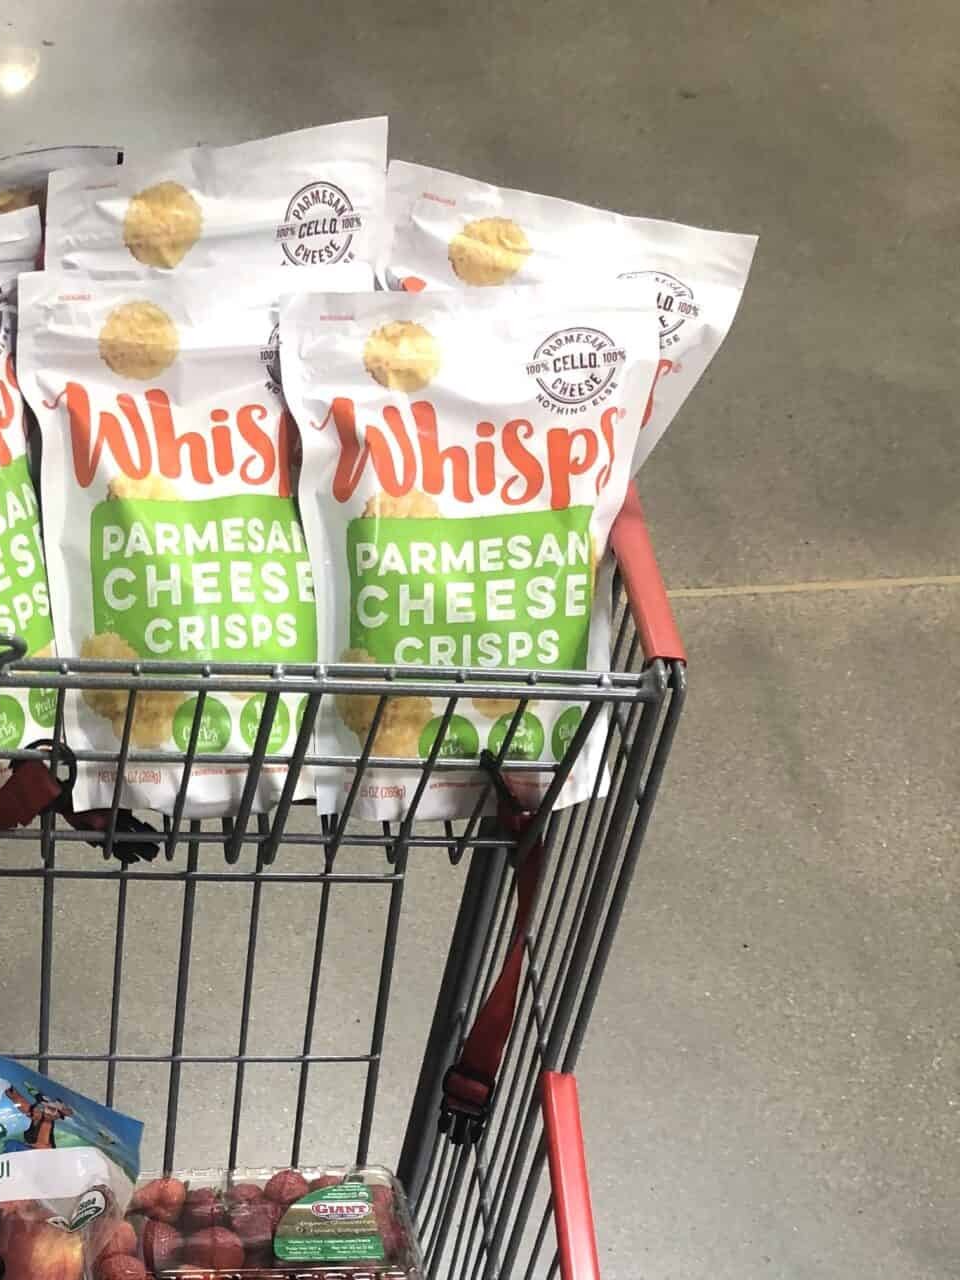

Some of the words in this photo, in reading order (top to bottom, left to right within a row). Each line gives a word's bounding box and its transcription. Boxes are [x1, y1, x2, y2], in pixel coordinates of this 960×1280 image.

[295, 239, 341, 264] CHEESE
[551, 372, 602, 397] CHEESE
[311, 397, 620, 511] Whisps
[356, 530, 590, 577] PARMESAN
[103, 561, 316, 612] CHEESE
[357, 574, 587, 629] CHEESE
[144, 613, 297, 654] CRISPS
[394, 629, 560, 667] CRISPS
